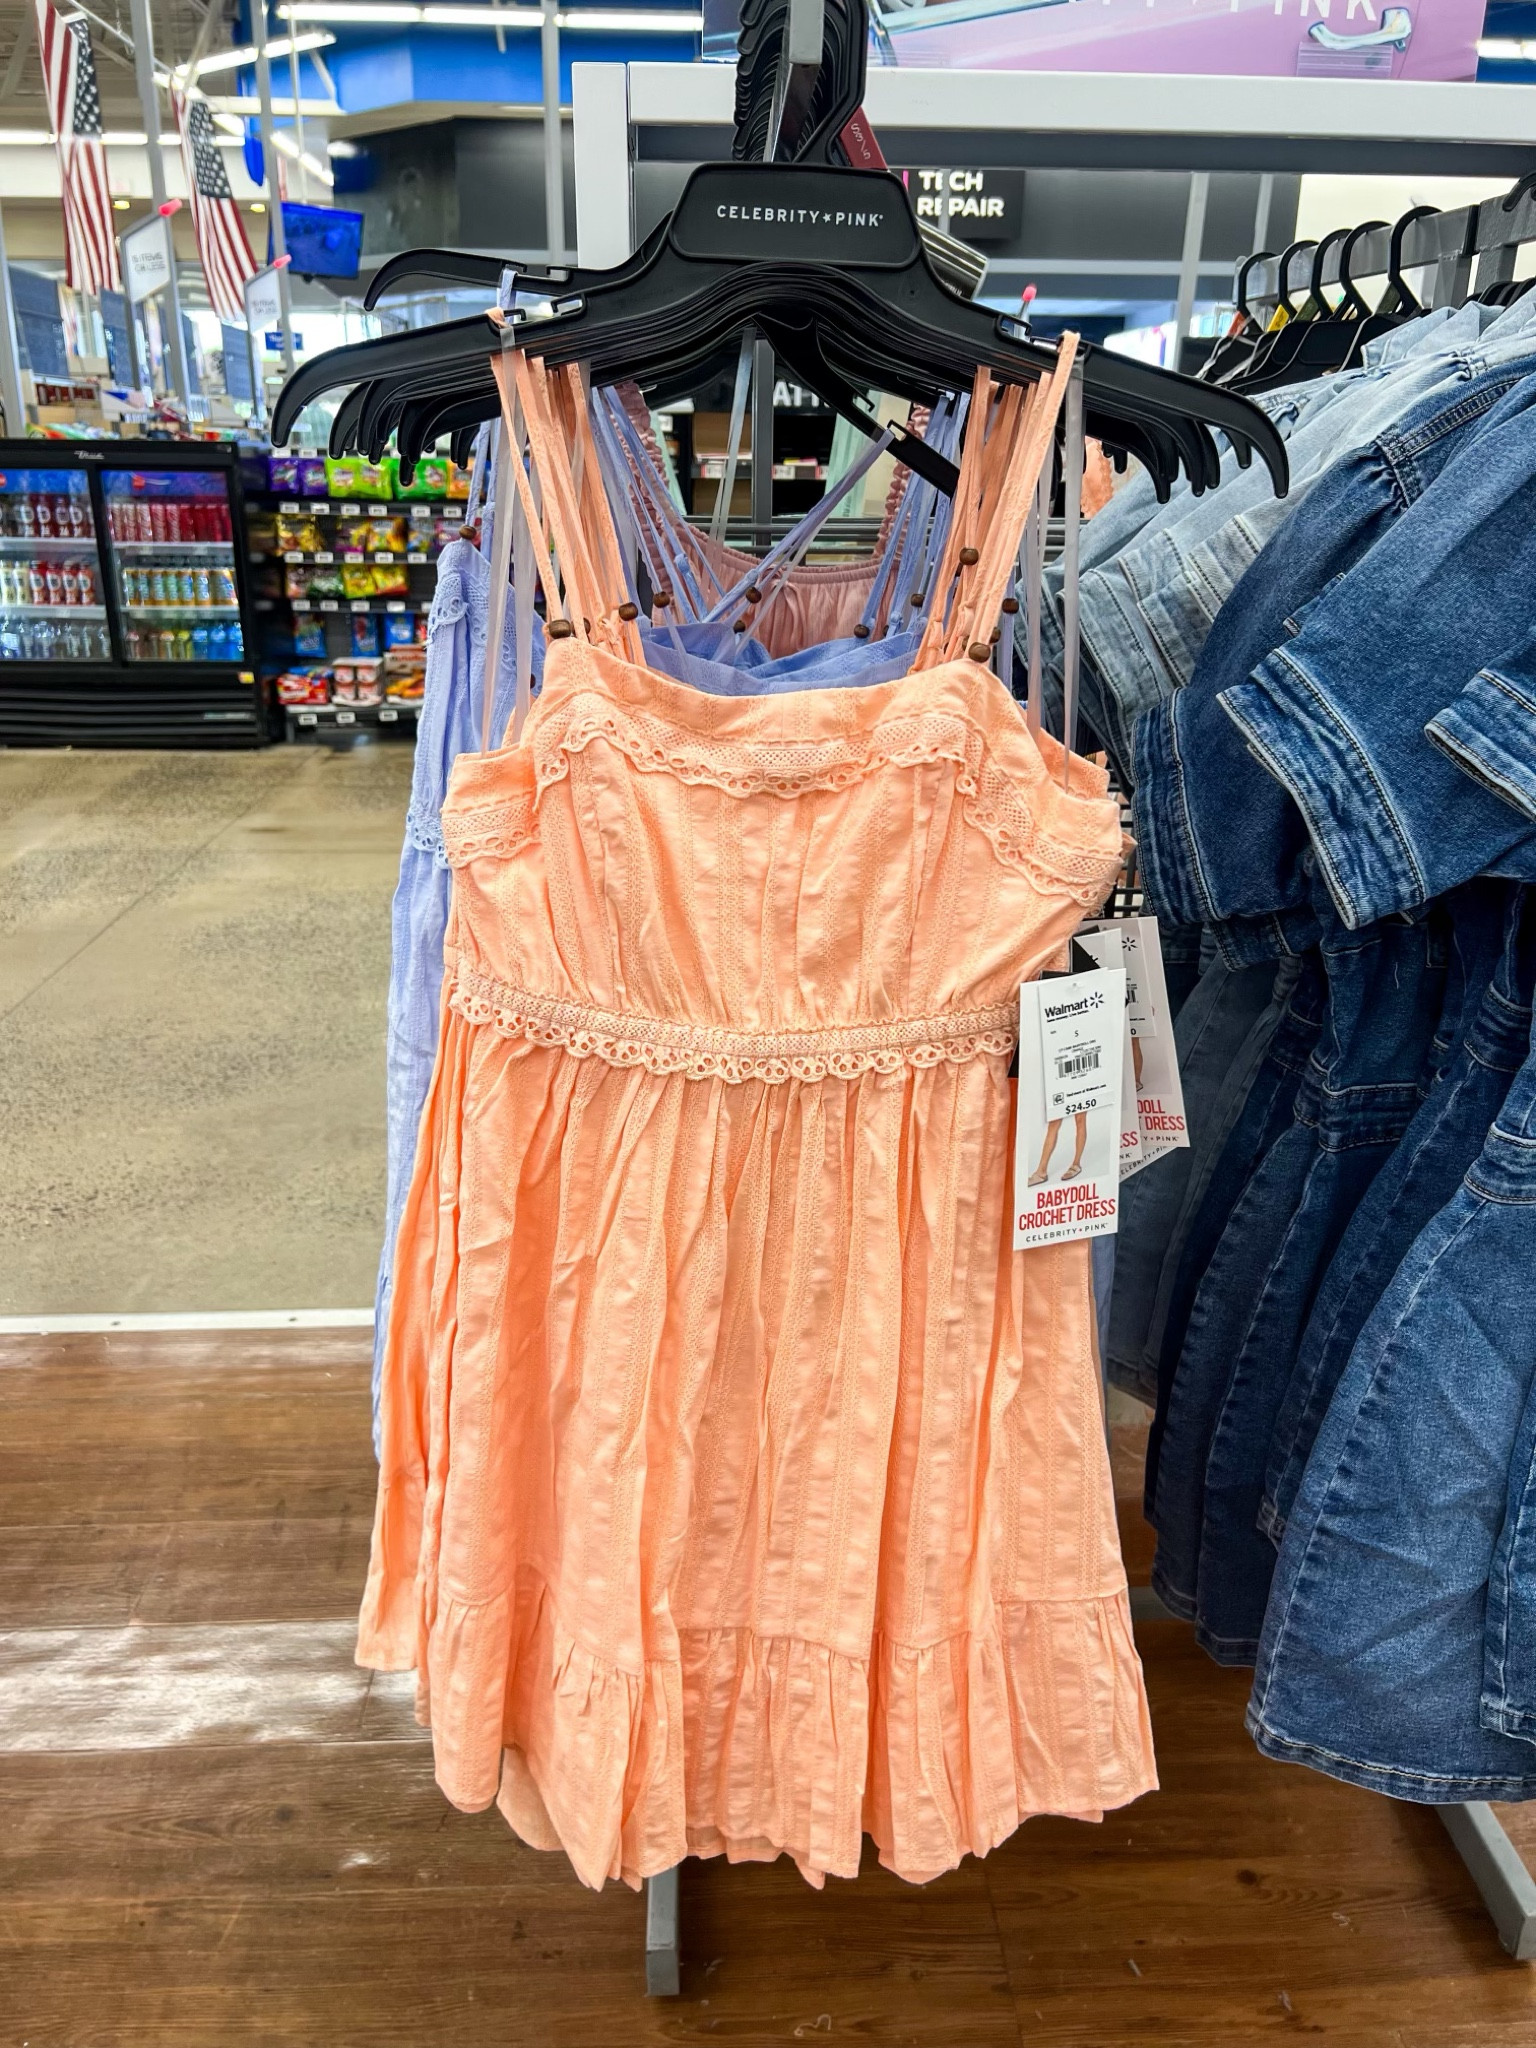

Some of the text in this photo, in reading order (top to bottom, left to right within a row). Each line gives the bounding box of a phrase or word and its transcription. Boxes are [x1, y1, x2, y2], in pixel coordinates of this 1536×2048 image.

[716, 205, 879, 227] CELEBRITY PINK
[1044, 998, 1089, 1018] Walmart
[1074, 1030, 1080, 1038] S
[1065, 1098, 1097, 1115] $24.50
[1137, 1099, 1166, 1114] DOLL
[1144, 1116, 1185, 1131] DRESS
[1036, 1183, 1099, 1209] BABYDOLL
[1018, 1198, 1116, 1231] CROCHET DRESS
[1025, 1223, 1107, 1243] CELEBRITY PINK
